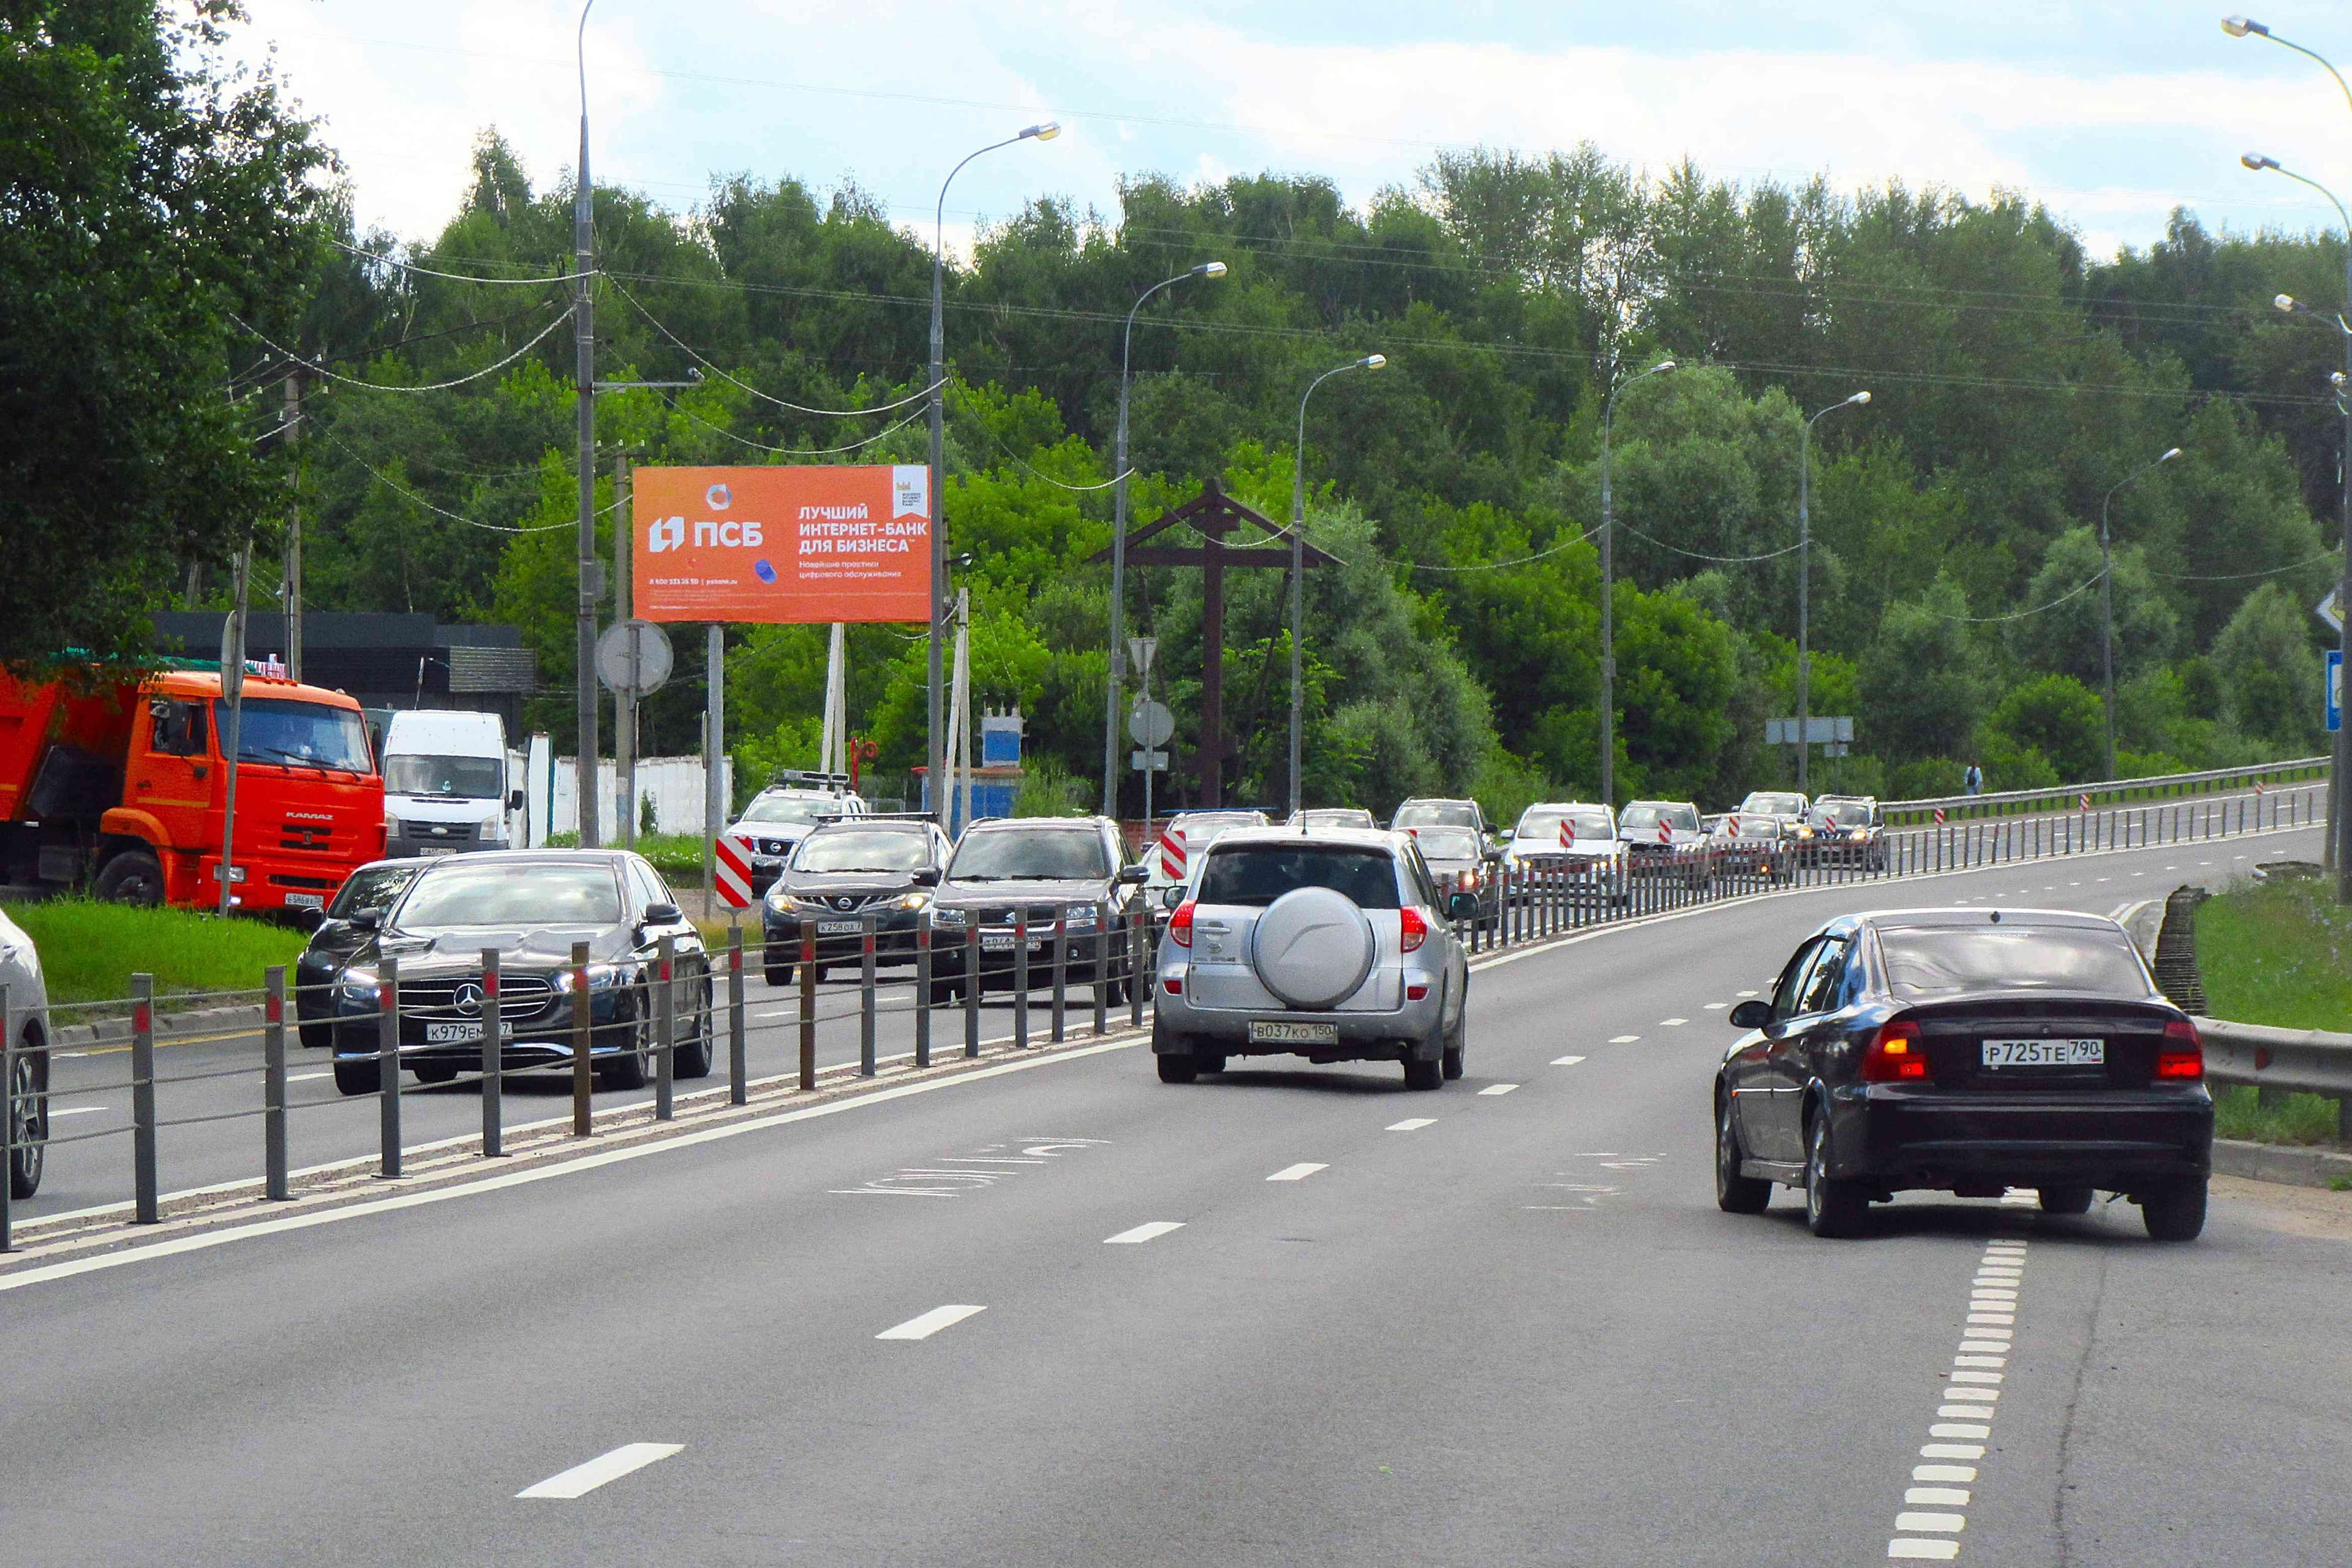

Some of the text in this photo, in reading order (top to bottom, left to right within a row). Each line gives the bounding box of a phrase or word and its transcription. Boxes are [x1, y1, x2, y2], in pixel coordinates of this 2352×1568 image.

[799, 503, 868, 519] ЛУЧШИЙ
[695, 521, 763, 547] ПСБ
[799, 522, 927, 536] ИНТЕРНЕТ-БАНК
[799, 540, 832, 554] ДЛЯ
[1257, 1024, 1331, 1038] В037КО 150
[1989, 1041, 2099, 1062] Р725ТЕ 790
